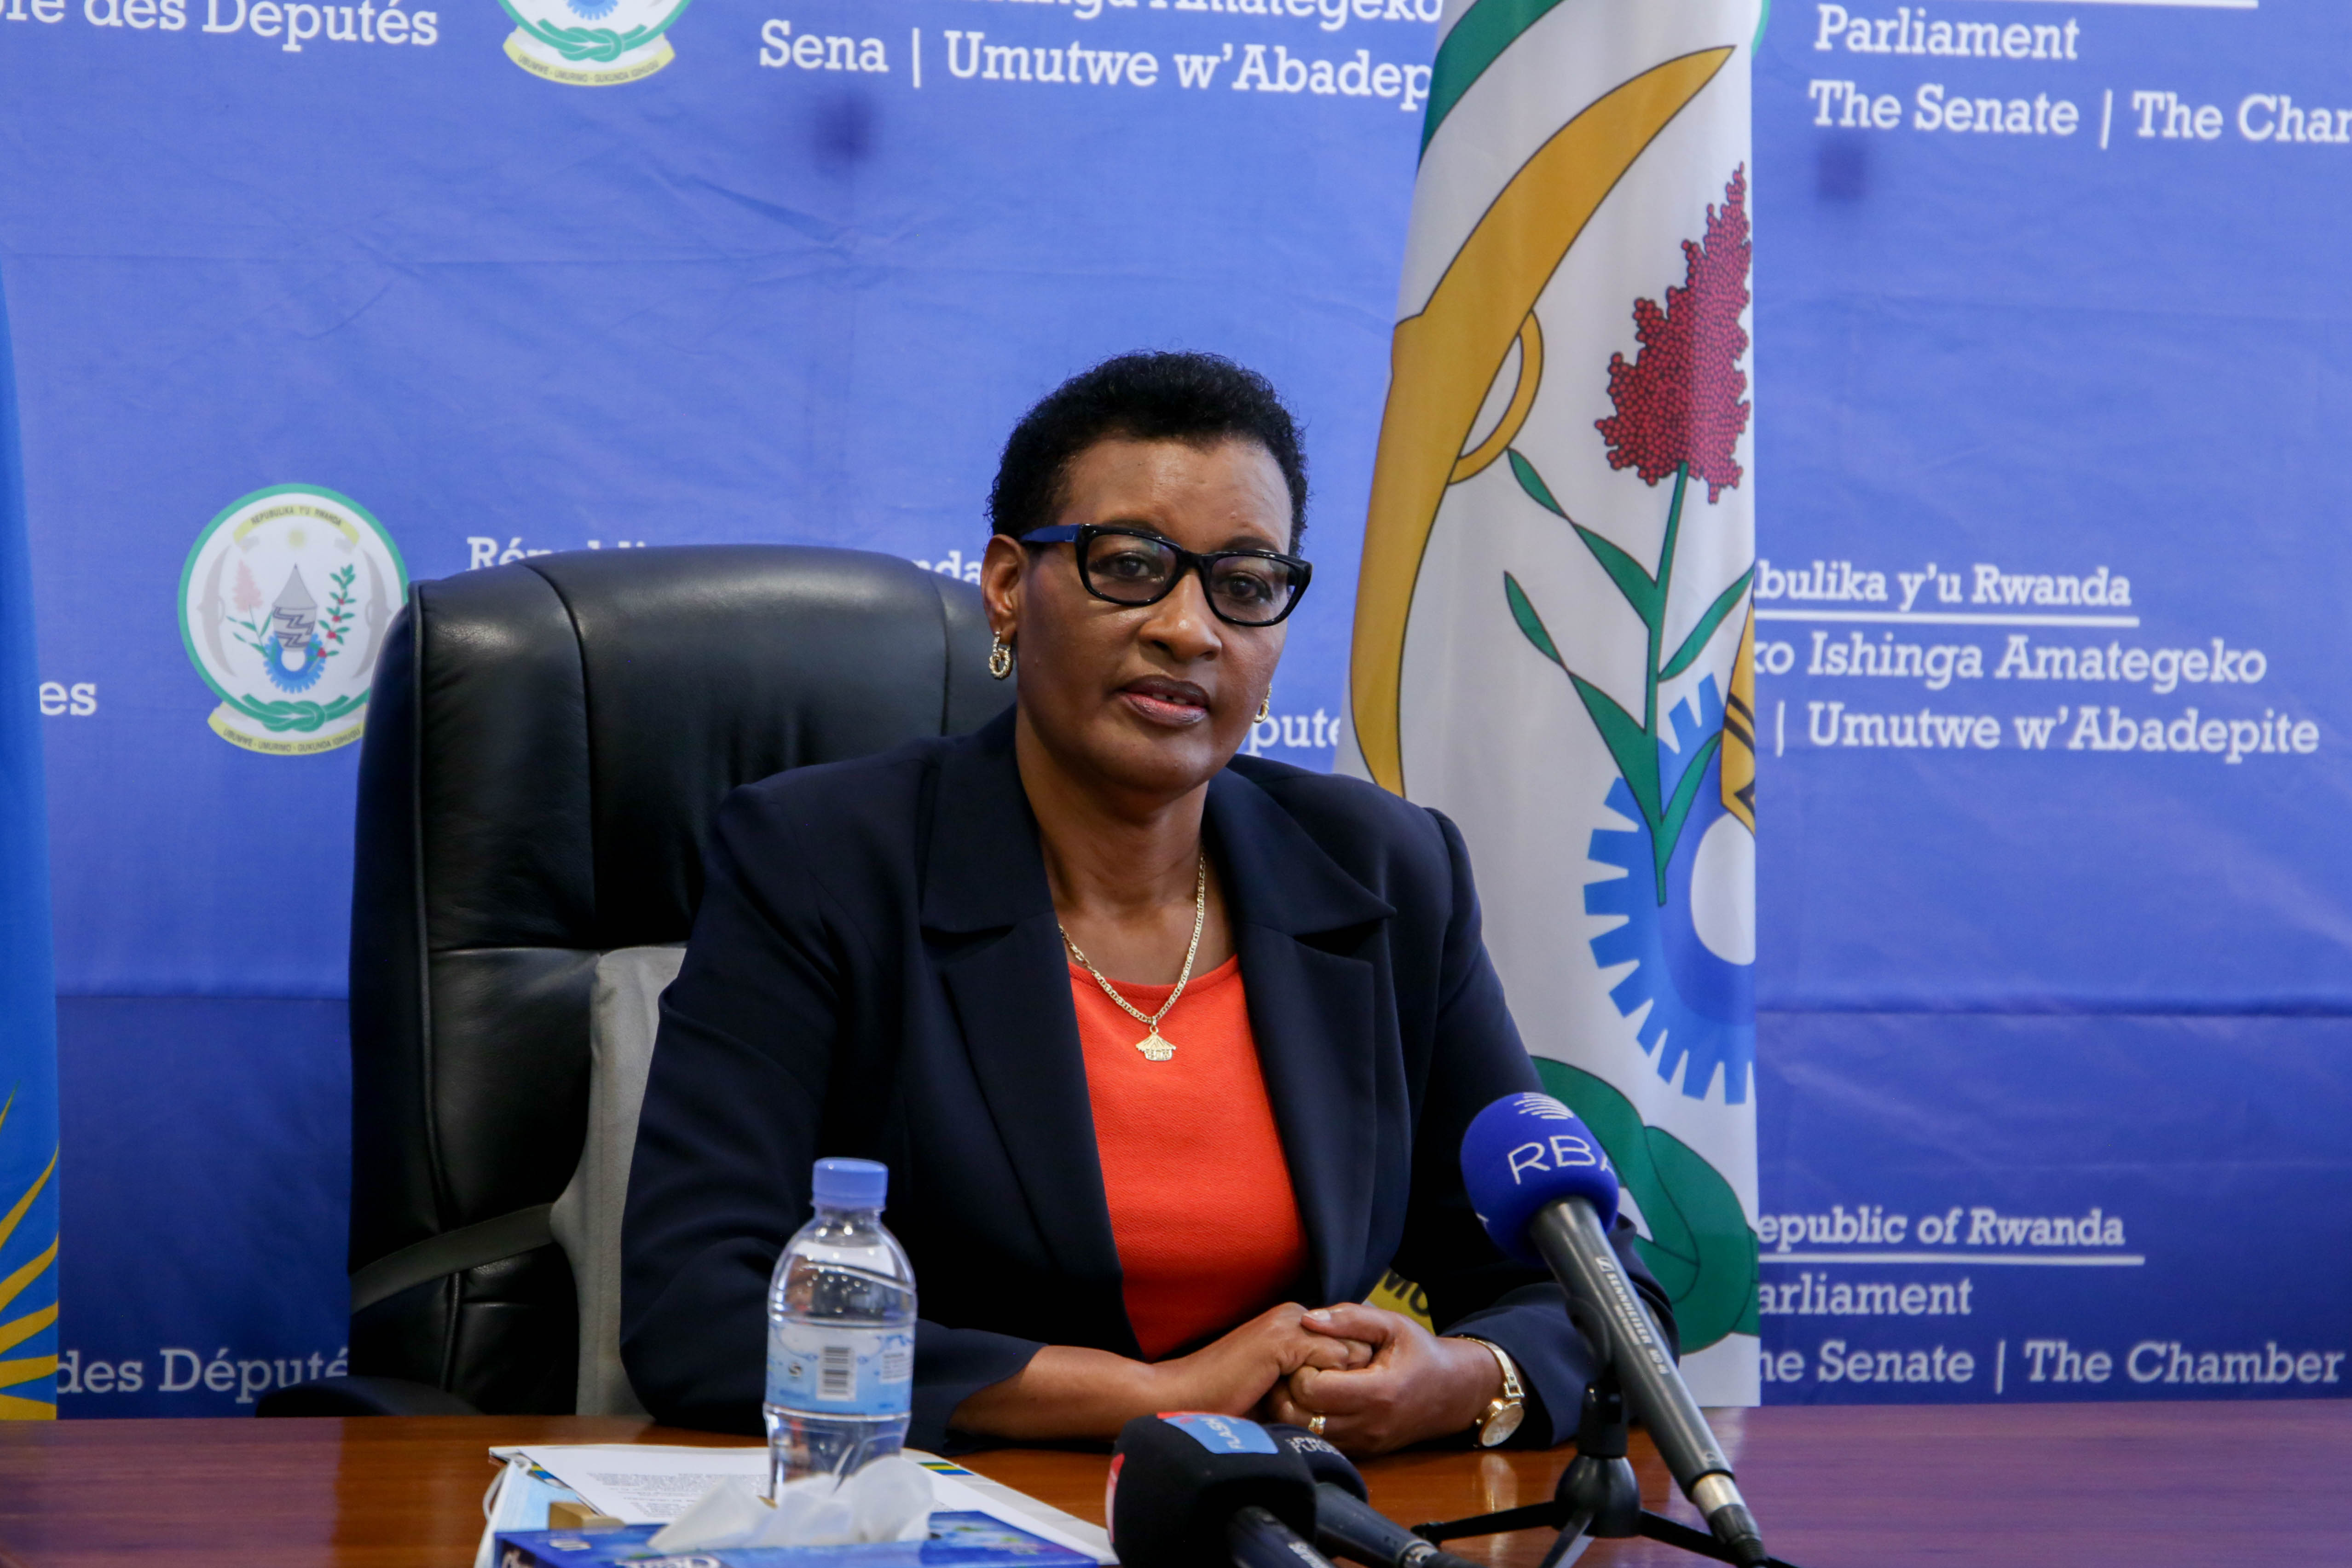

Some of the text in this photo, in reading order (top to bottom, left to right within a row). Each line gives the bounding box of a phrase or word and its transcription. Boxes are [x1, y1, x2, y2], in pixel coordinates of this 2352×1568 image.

[84, 0, 187, 31] des
[1815, 3, 2080, 60] Parliament
[760, 19, 889, 72] Sena
[944, 30, 1158, 87] Umutwe
[1809, 80, 1901, 129] The
[1914, 83, 2079, 135] Senate
[2132, 91, 2223, 139] The
[1755, 560, 2131, 612] bulika y'u Rwanda
[1808, 631, 1983, 690] Ishinga
[1994, 635, 2267, 694] Amategeko
[1809, 702, 2319, 764] Umutwe w'Abadepite
[1758, 1205, 2125, 1253] epublic of Rwanda
[56, 1350, 143, 1394] des
[1818, 1340, 1974, 1382] Senate
[2024, 1340, 2112, 1382] The
[2127, 1341, 2344, 1383] Chamber
